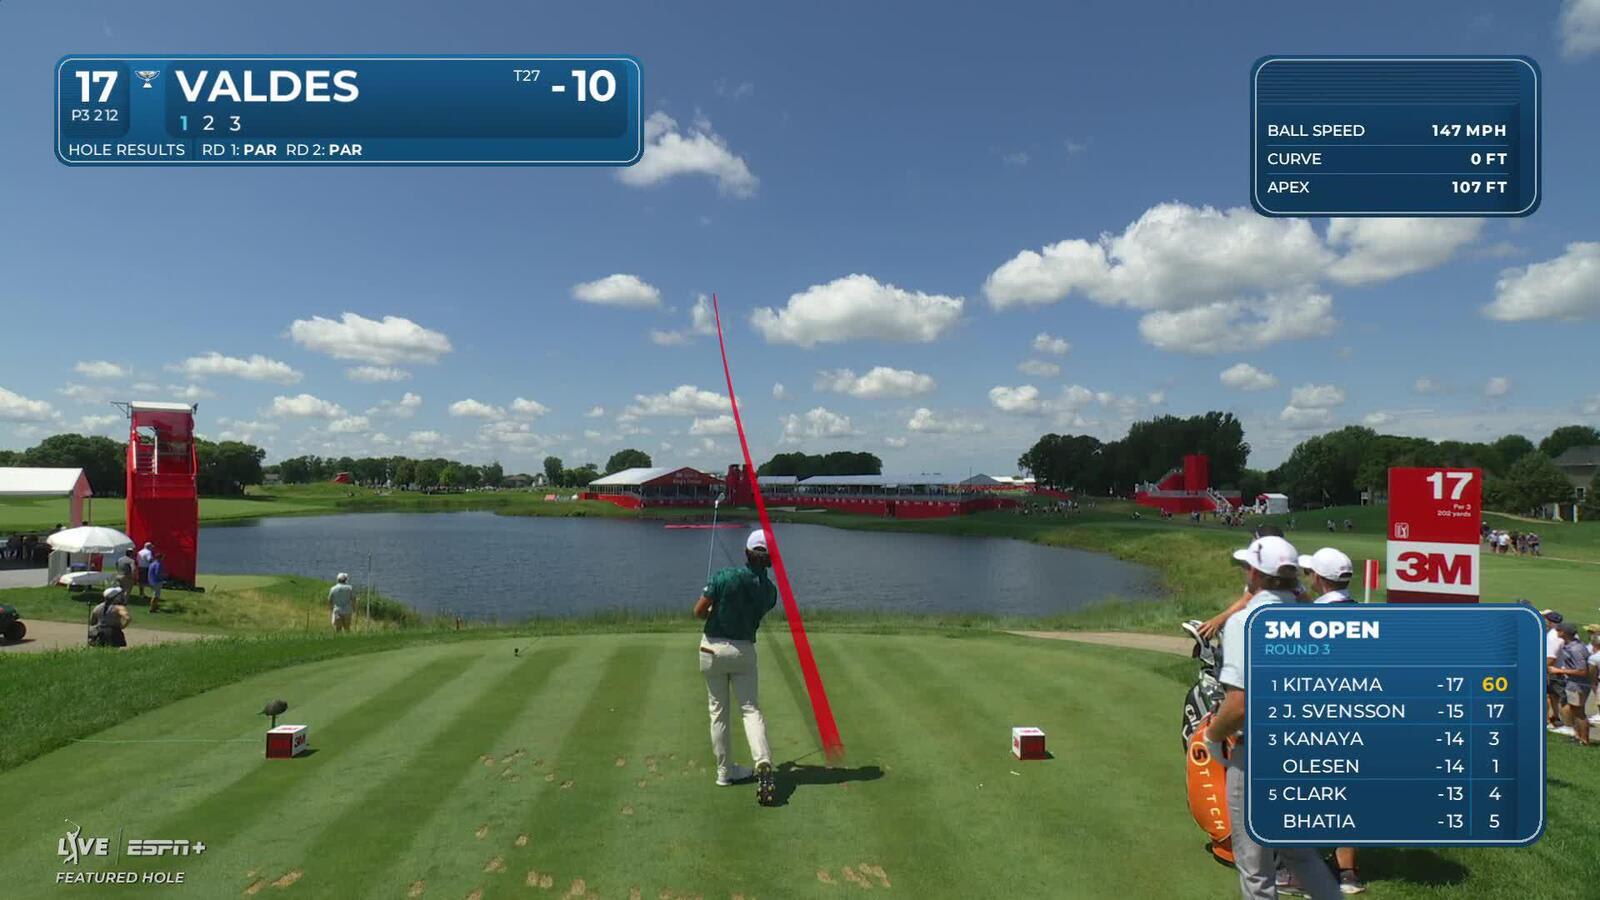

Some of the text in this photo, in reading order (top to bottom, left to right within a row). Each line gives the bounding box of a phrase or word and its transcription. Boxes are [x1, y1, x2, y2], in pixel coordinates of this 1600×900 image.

[1426, 471, 1474, 500] 17
[1395, 551, 1472, 586] 3M
[1190, 742, 1226, 830] STITCH
